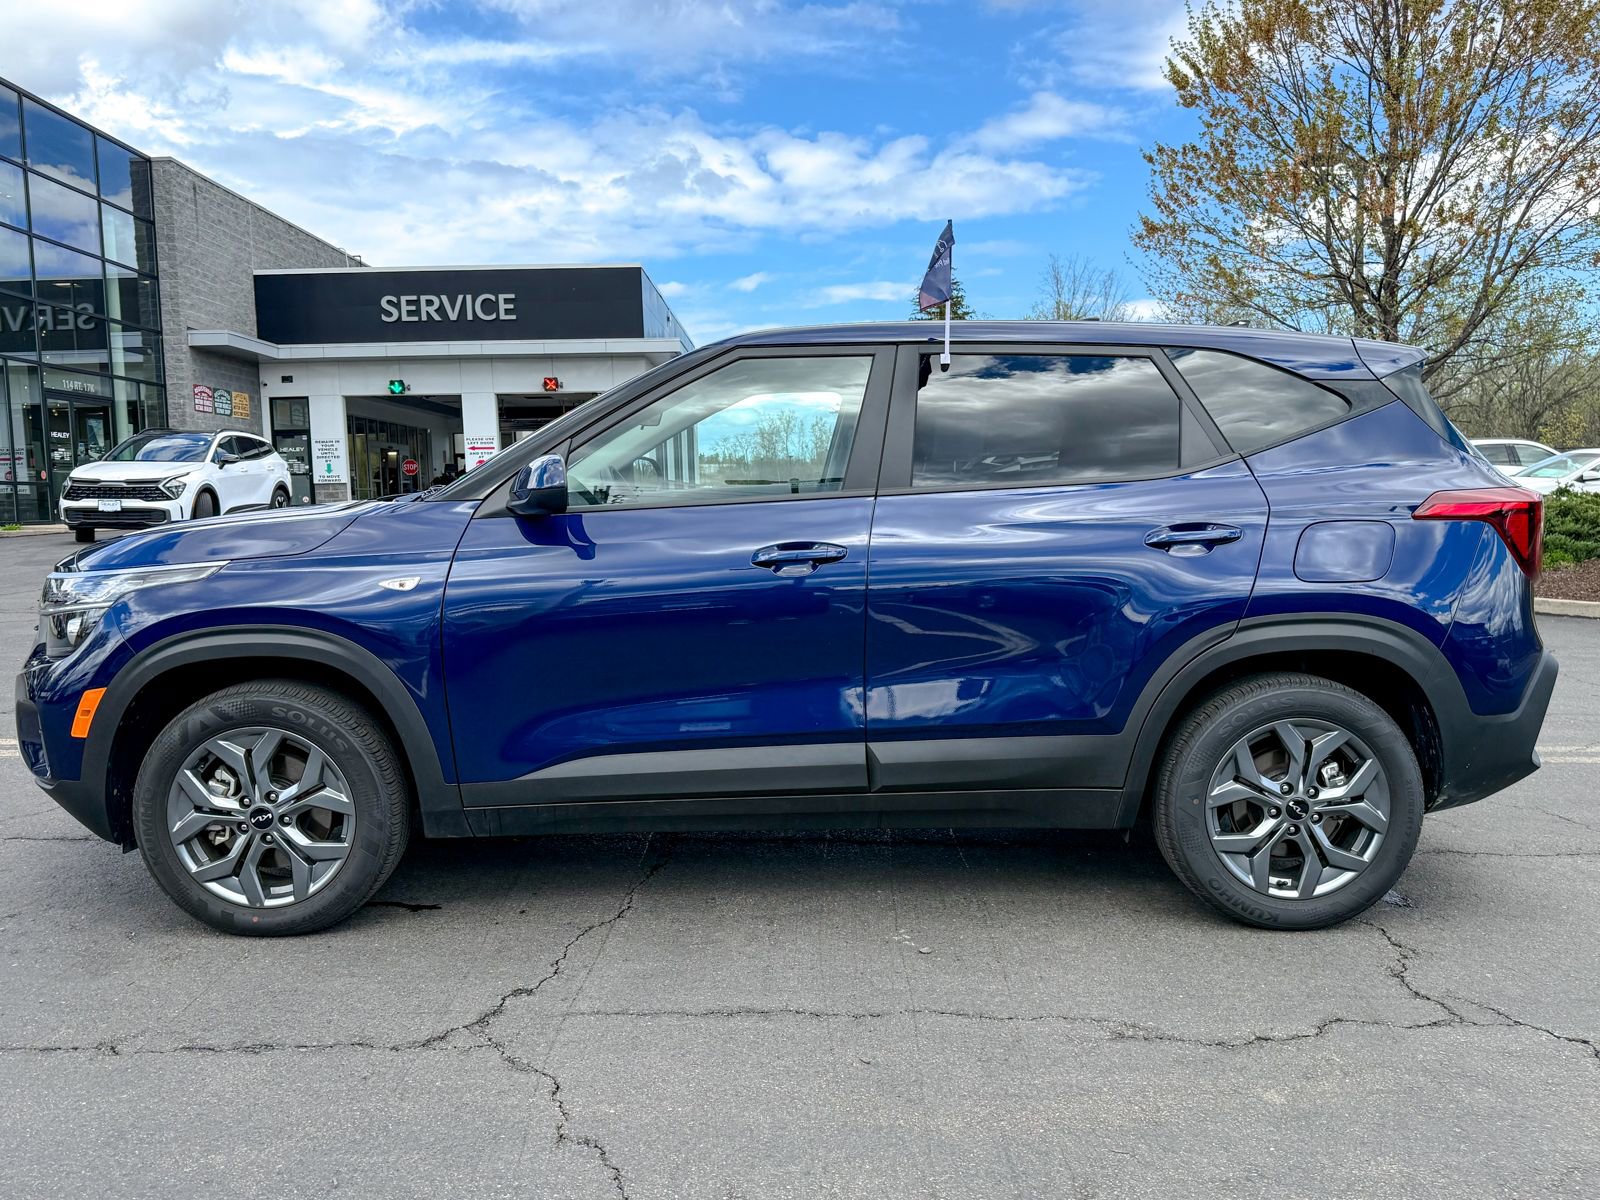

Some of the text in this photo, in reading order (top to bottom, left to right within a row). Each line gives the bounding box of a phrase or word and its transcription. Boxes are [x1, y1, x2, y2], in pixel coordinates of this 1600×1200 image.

[380, 293, 517, 323] SERVICE
[62, 379, 74, 390] 114
[83, 383, 95, 393] 17K
[50, 431, 70, 439] HEALEY
[271, 705, 349, 752] SOLUS
[1217, 696, 1296, 737] SOLUS
[1208, 877, 1281, 922] KUMHO
